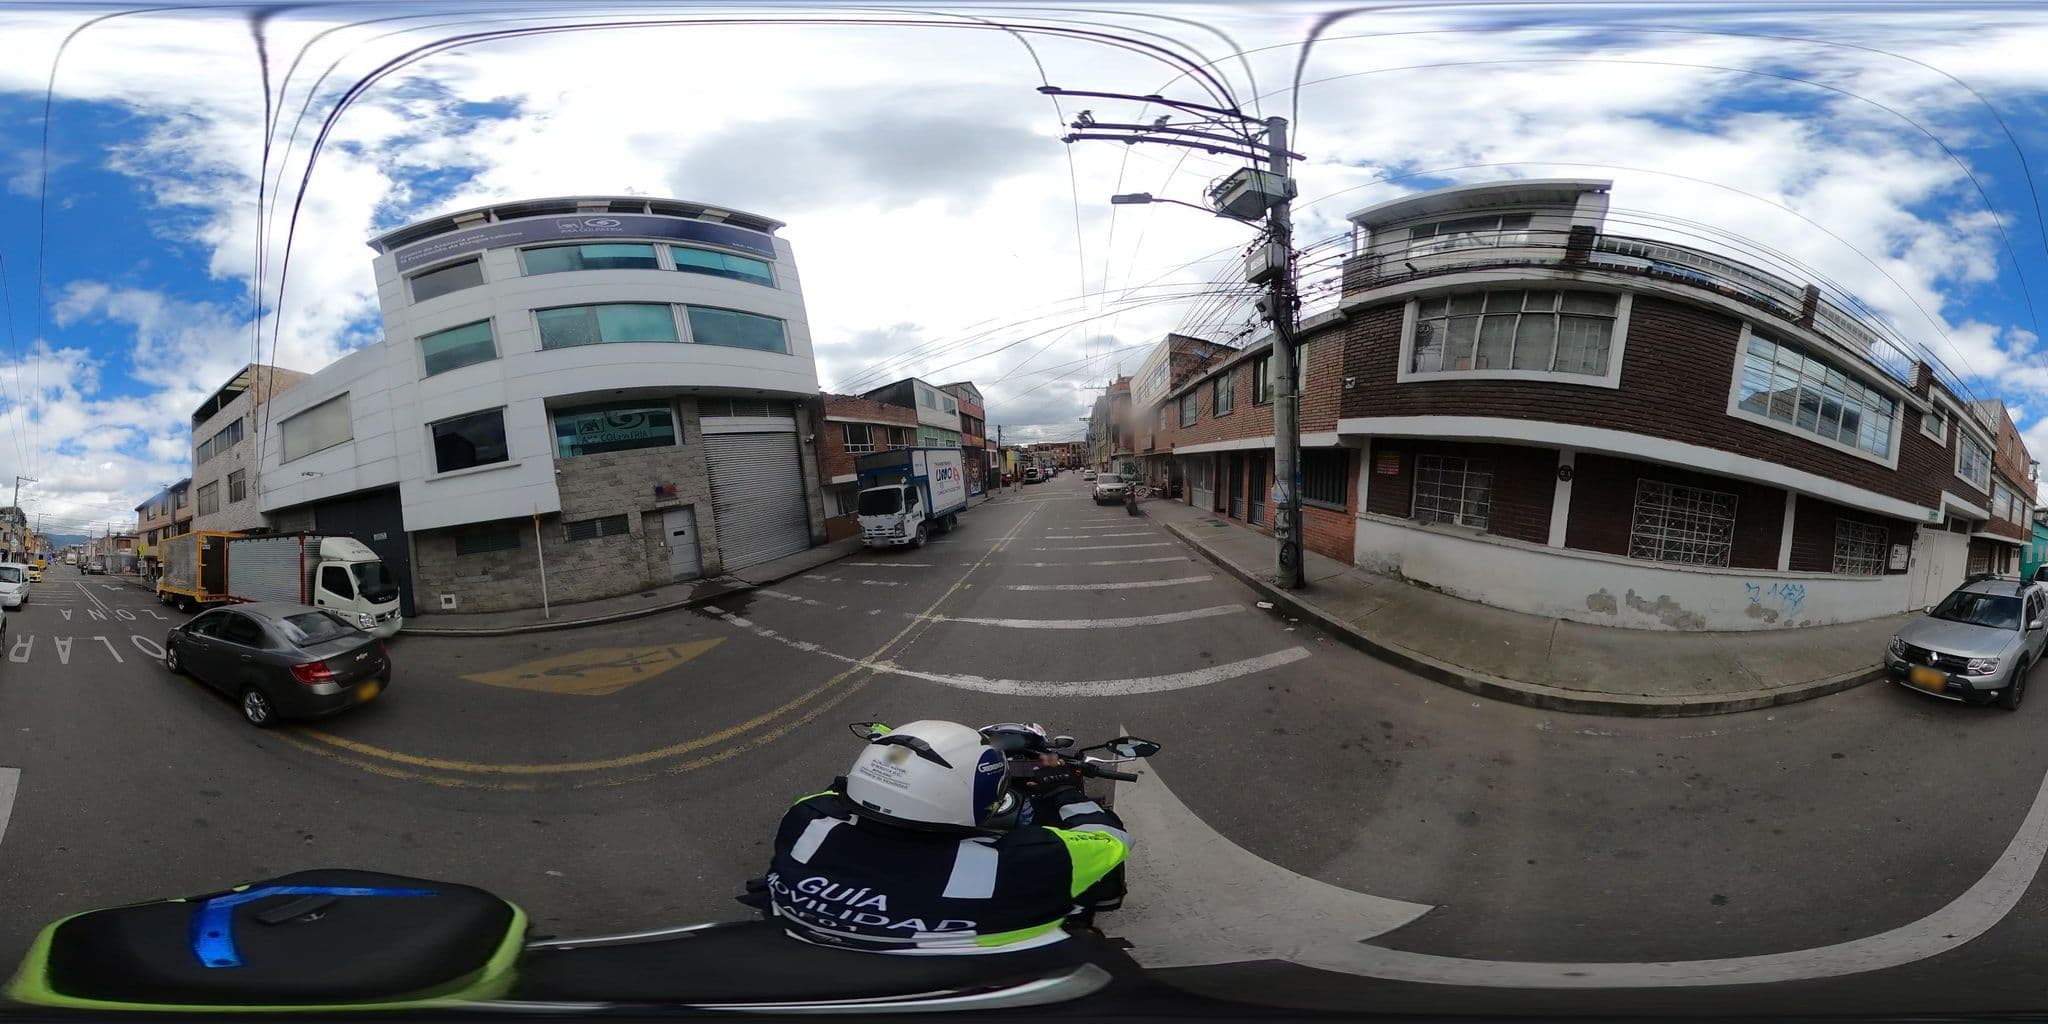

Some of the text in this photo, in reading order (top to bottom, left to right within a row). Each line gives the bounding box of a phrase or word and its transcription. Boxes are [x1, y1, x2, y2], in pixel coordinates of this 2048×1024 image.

[60, 608, 168, 621] ZONA
[767, 872, 977, 932] MOVILIDAD
[796, 876, 888, 912] GUÍA
